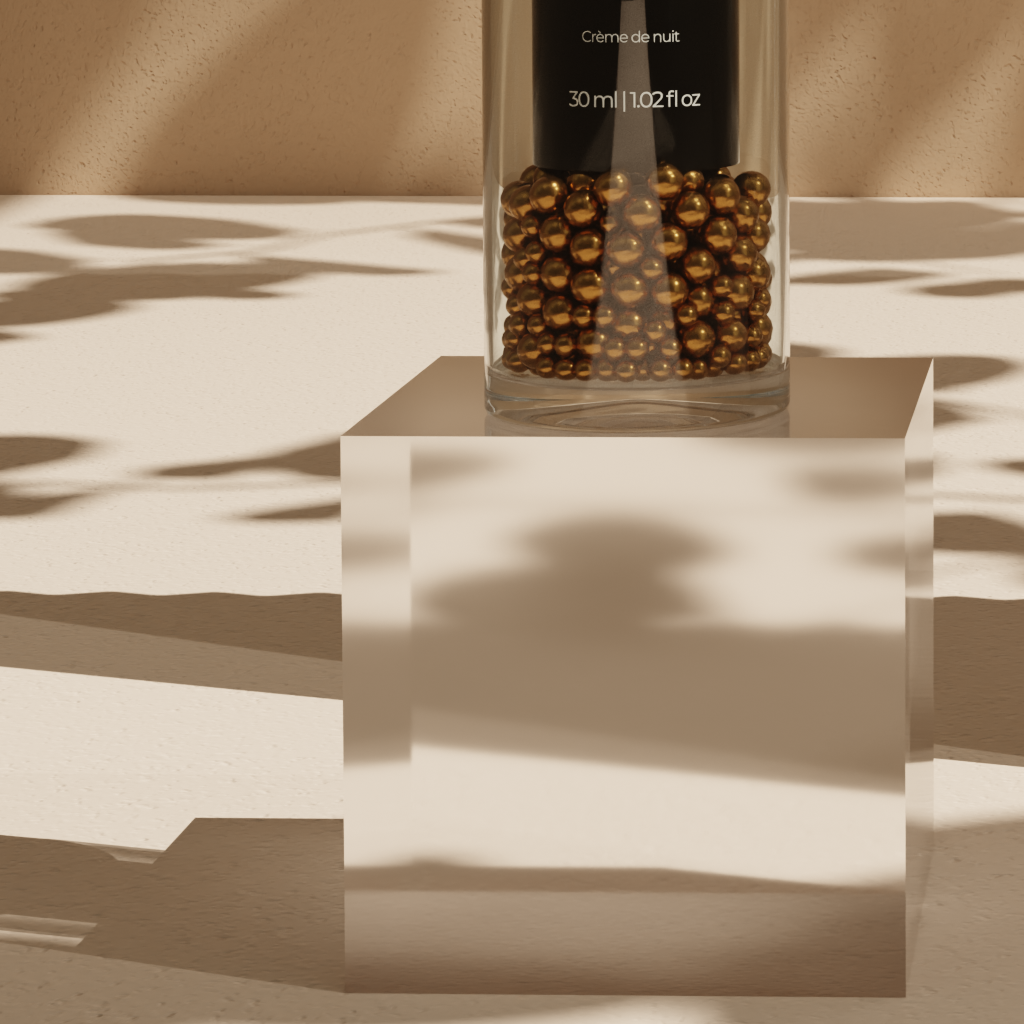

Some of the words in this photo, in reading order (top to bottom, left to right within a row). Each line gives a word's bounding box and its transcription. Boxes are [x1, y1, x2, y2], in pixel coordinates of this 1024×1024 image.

[581, 30, 629, 44] Crème
[630, 30, 651, 44] de
[652, 29, 681, 44] nuit
[568, 90, 591, 108] 30
[593, 90, 618, 109] ml
[629, 90, 665, 109] 1.02
[665, 89, 679, 108] fl
[681, 92, 702, 108] oz
